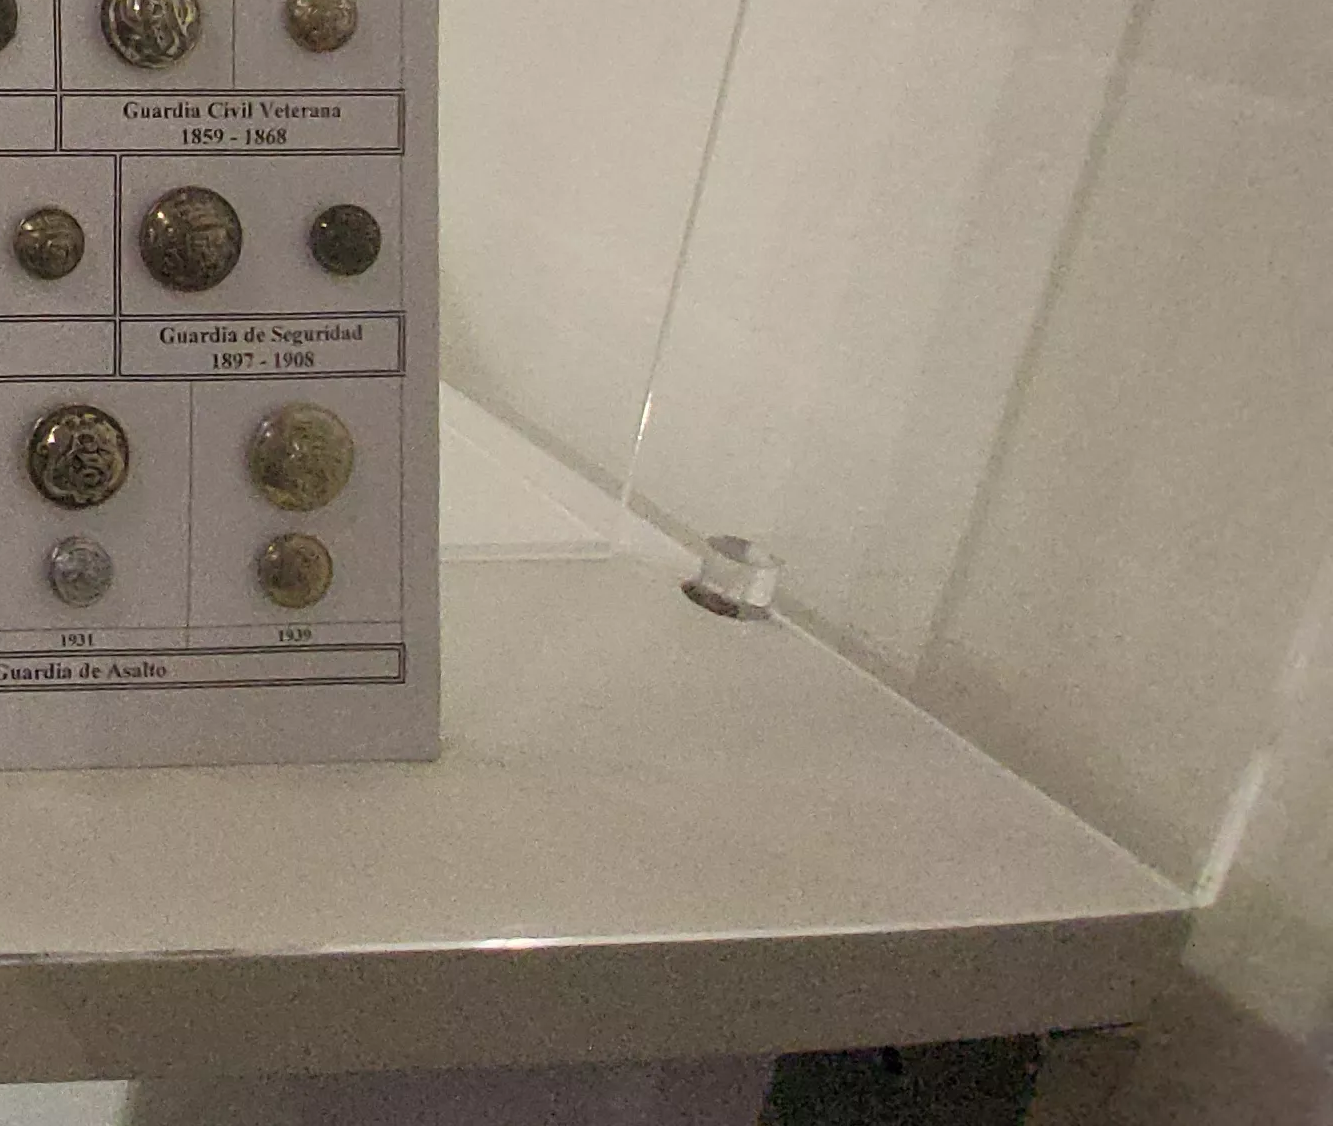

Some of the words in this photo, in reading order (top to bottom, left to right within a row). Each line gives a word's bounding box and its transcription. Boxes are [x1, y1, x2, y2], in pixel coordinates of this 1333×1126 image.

[122, 100, 201, 120] Guardia
[207, 101, 253, 119] Civil
[259, 101, 341, 119] Veterana
[182, 127, 225, 146] 1859
[245, 128, 287, 146] 1868
[159, 325, 238, 345] Guardia
[243, 326, 266, 344] de
[270, 324, 363, 346] Seguridad
[213, 352, 255, 369] 1897
[274, 350, 315, 369] 1908
[61, 633, 94, 648] 1931
[278, 628, 313, 643] 1939
[78, 661, 102, 679] de
[108, 660, 167, 678] Asalto
